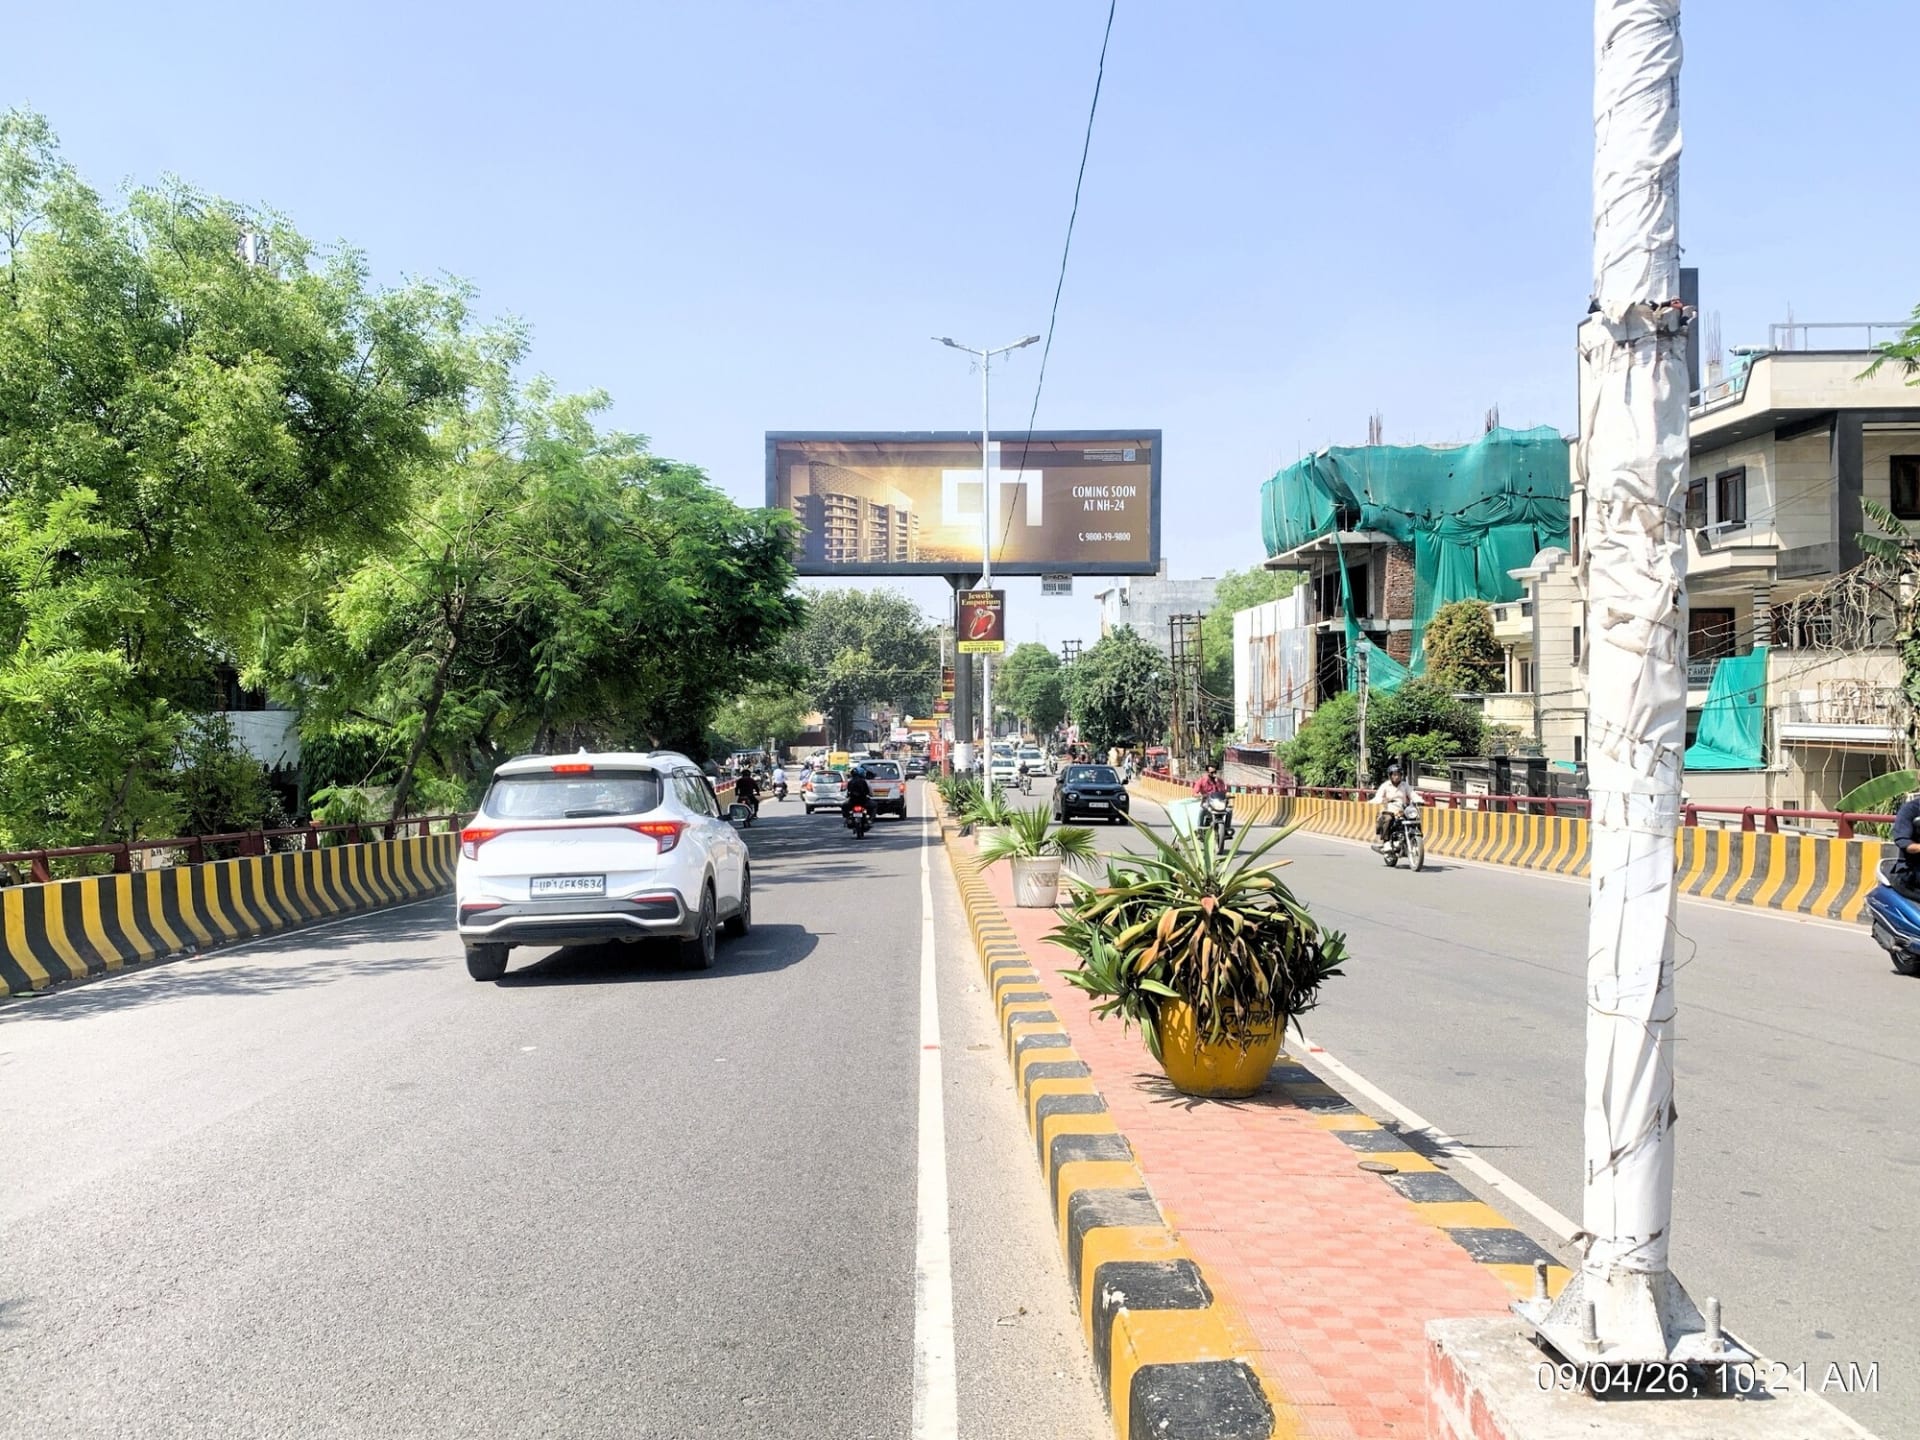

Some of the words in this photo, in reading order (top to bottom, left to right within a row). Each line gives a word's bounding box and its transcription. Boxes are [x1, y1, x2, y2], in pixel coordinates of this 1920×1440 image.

[1072, 486, 1109, 498] COMING
[1111, 485, 1137, 498] SOON
[1083, 499, 1096, 511] AT
[1096, 499, 1125, 511] NH-24
[961, 599, 1001, 608] Emporium
